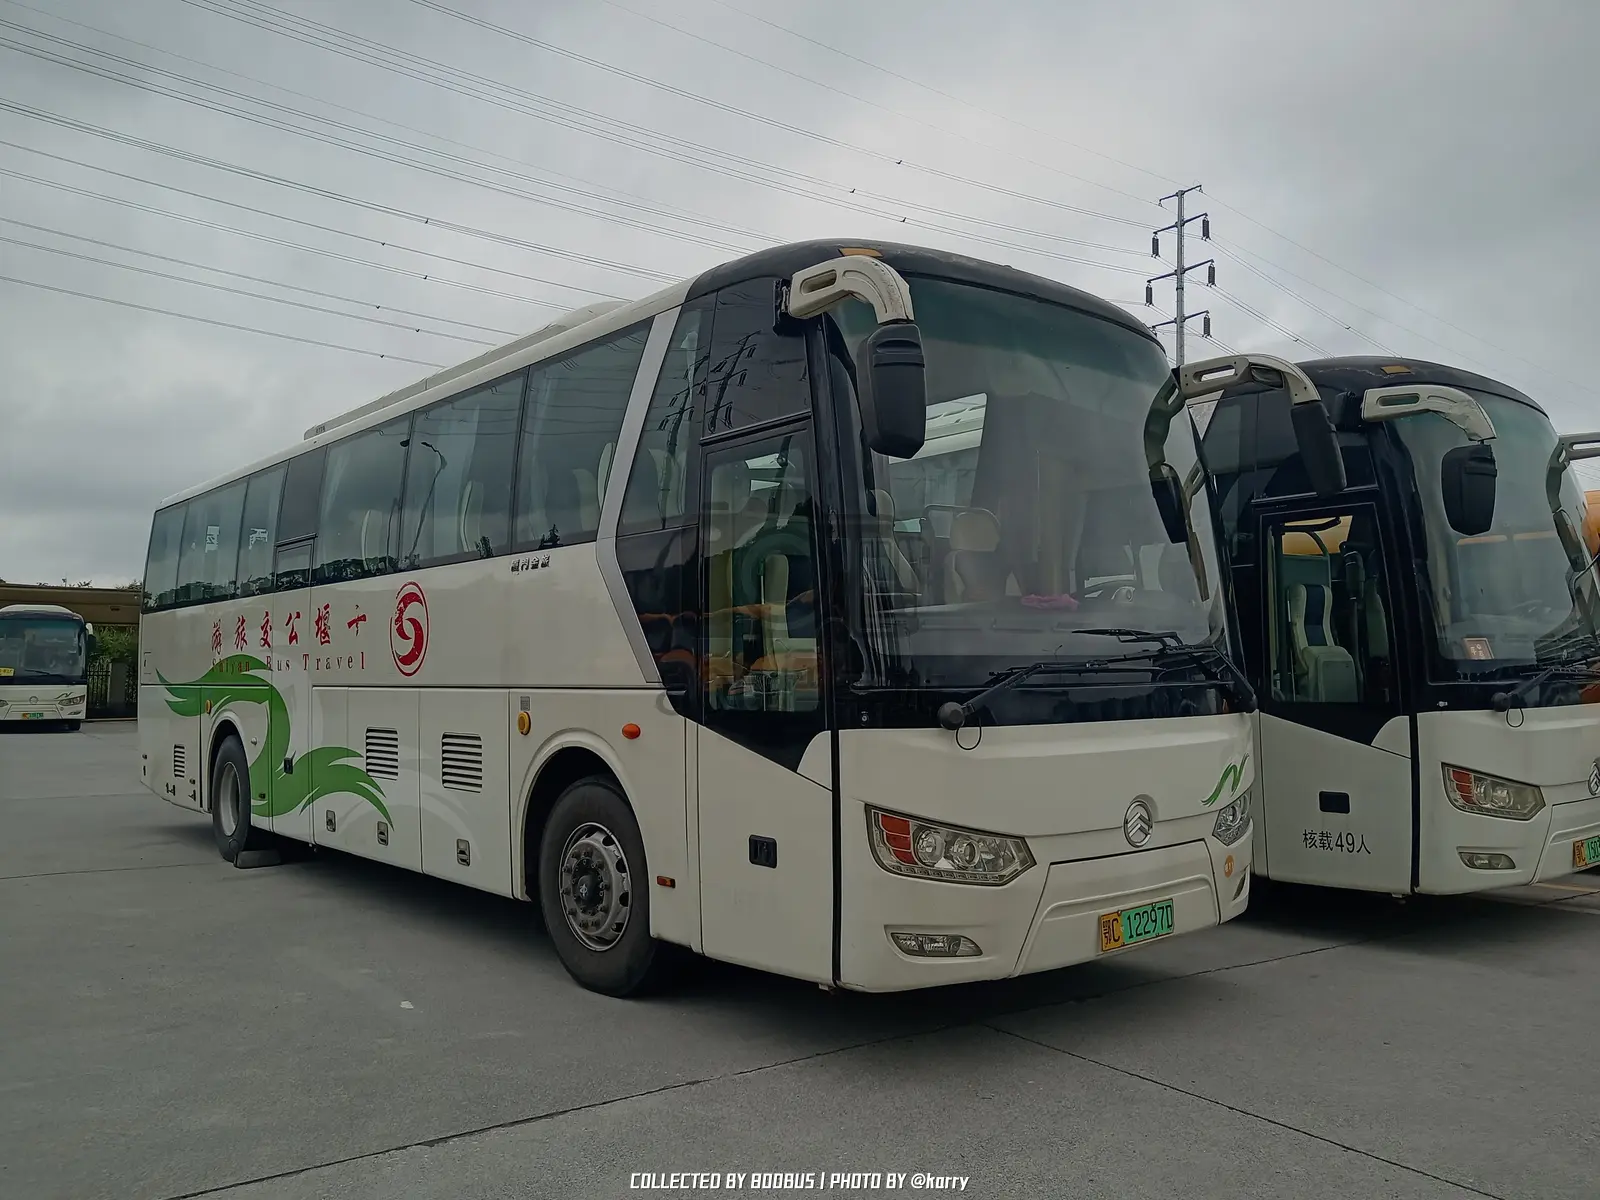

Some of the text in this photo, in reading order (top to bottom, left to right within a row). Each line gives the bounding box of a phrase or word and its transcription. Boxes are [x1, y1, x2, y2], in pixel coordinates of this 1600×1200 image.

[266, 655, 290, 671] Bus
[303, 652, 365, 671] Travel
[1302, 829, 1372, 855] 核载49人
